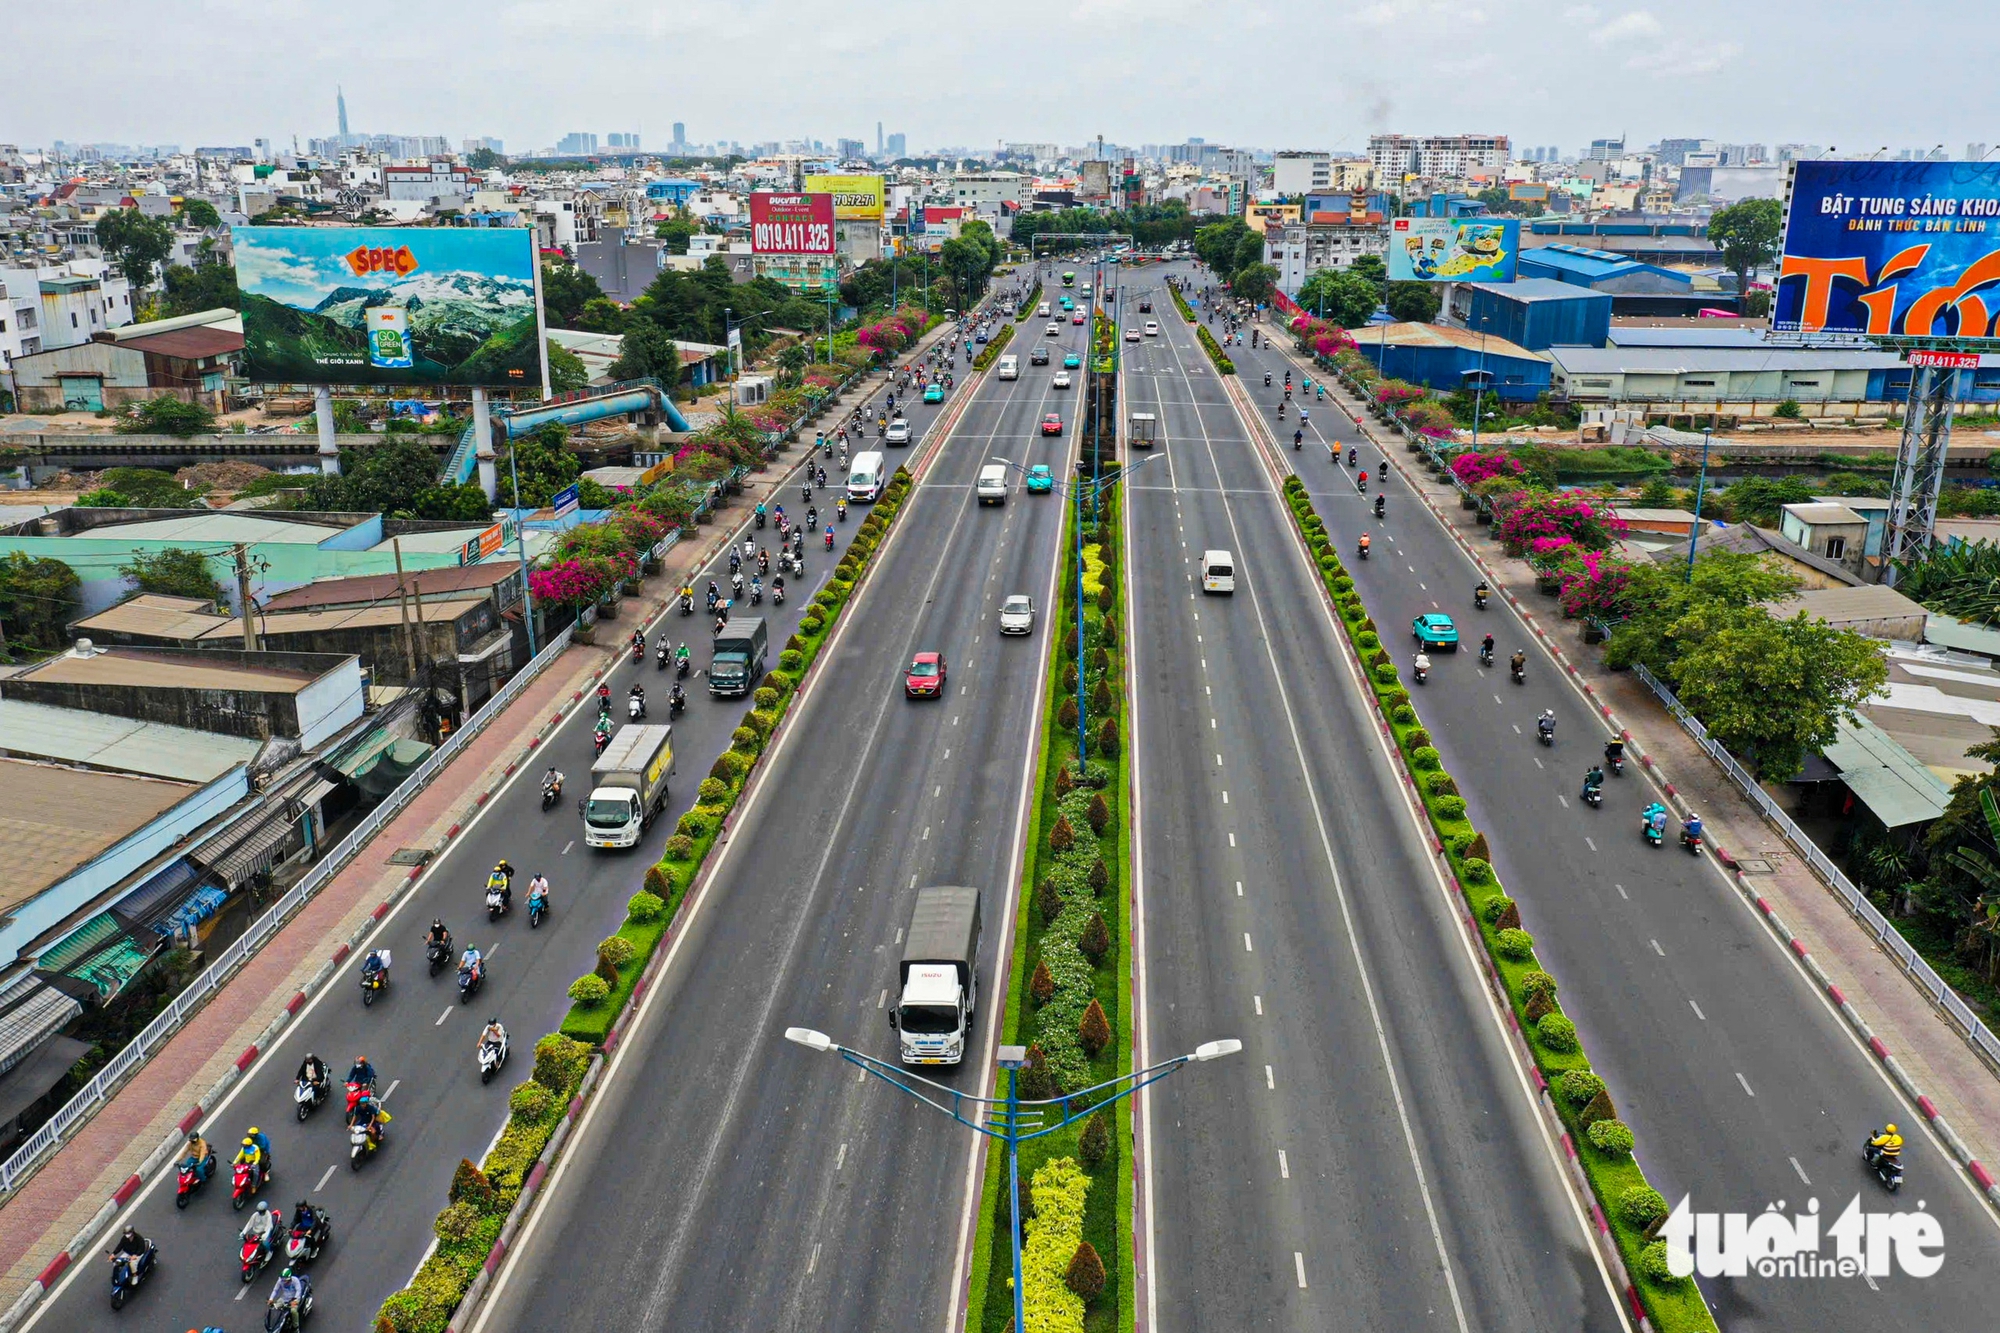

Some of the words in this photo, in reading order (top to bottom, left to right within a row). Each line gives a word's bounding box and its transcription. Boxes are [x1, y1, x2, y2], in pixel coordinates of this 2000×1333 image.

[1821, 193, 1854, 219] BẬT
[1860, 197, 1905, 214] TUNG
[1910, 193, 1957, 215] SẢNG
[768, 214, 814, 222] CONTACT
[1848, 216, 1882, 231] ĐÁNH
[754, 222, 830, 251] 0919.411.325
[355, 249, 409, 272] SPEC
[379, 331, 396, 341] GO
[316, 357, 328, 365] THẾ
[1909, 354, 1978, 369] 0919.411.325
